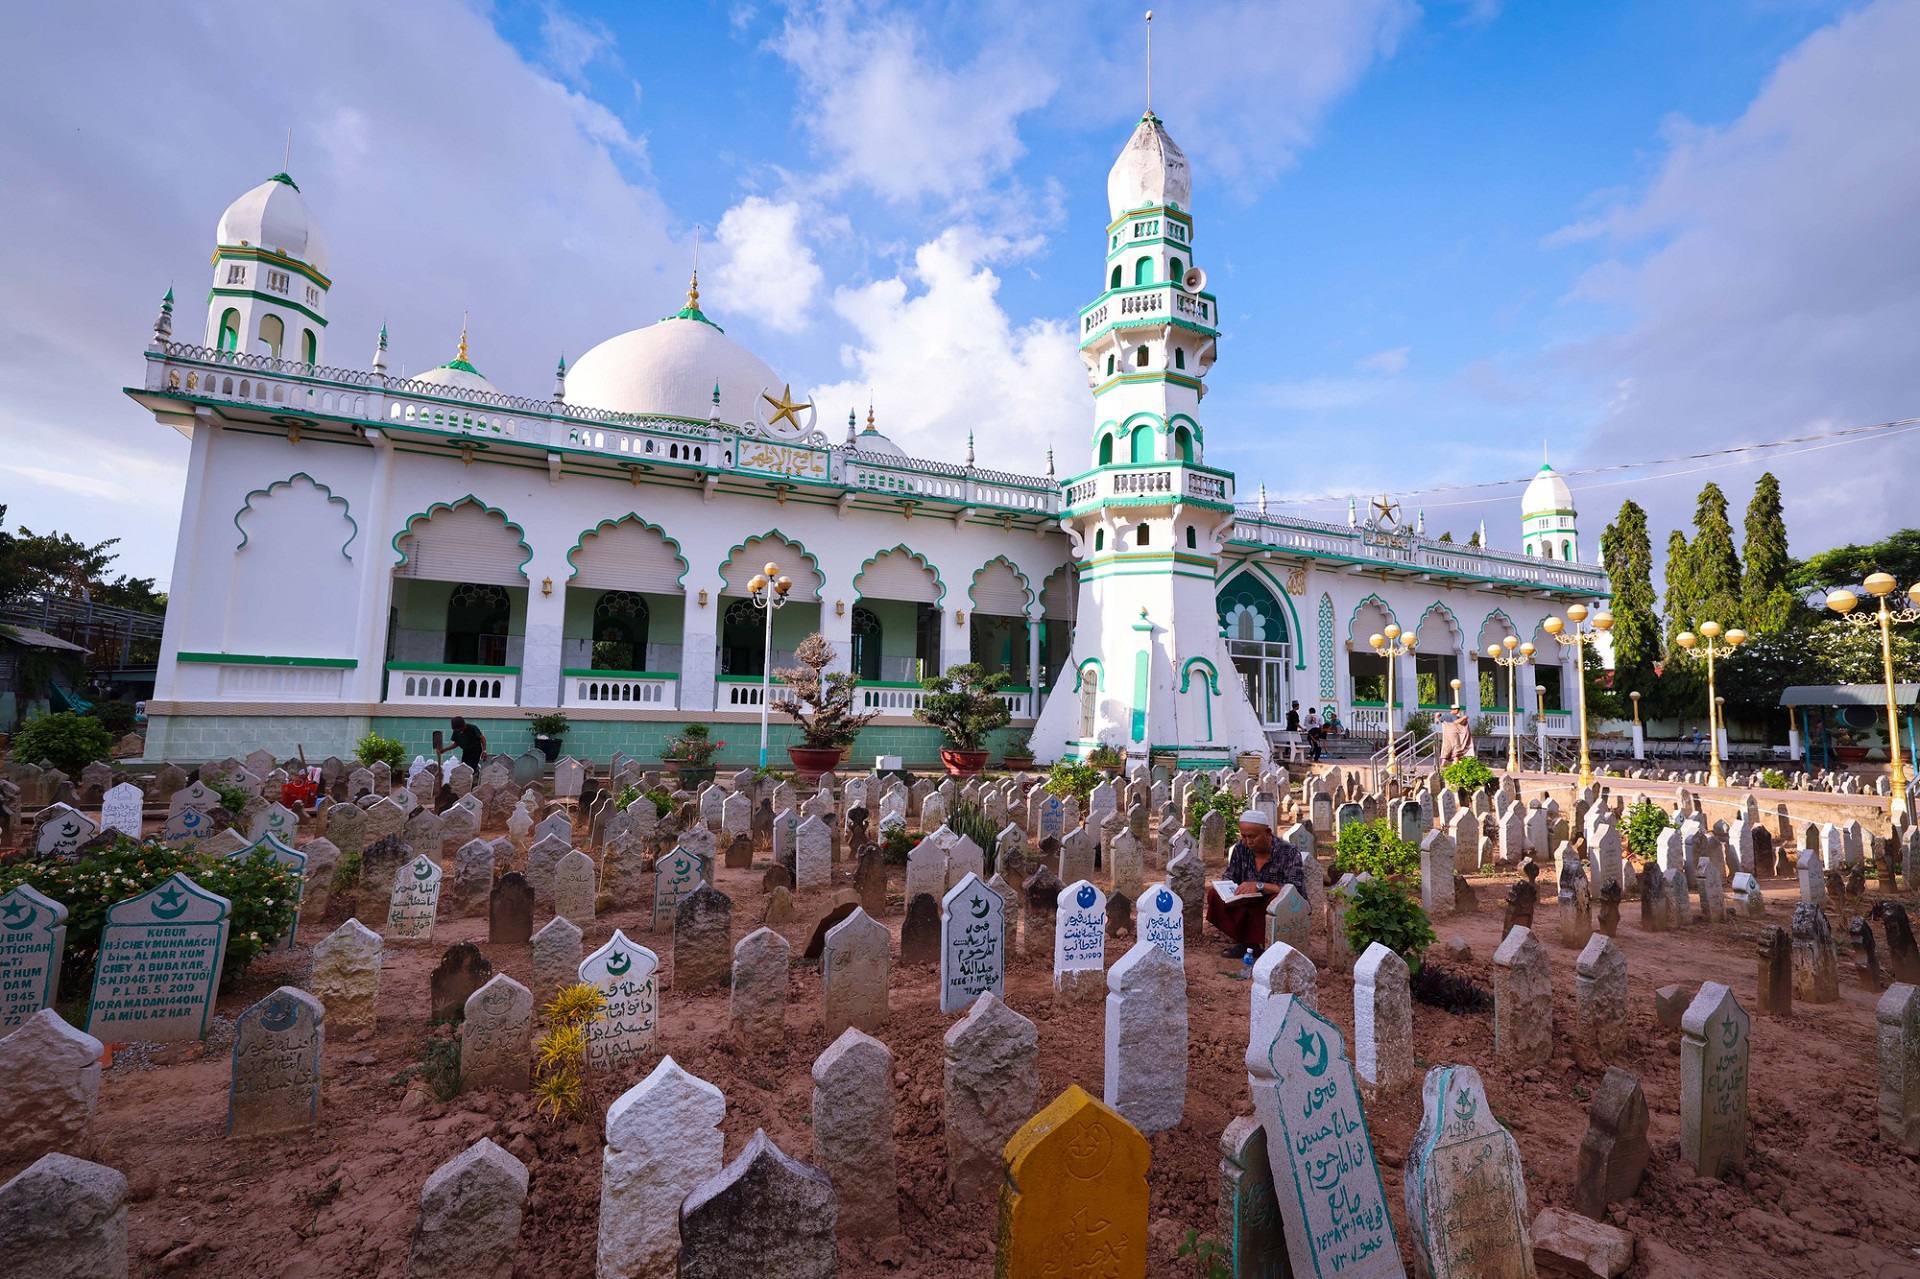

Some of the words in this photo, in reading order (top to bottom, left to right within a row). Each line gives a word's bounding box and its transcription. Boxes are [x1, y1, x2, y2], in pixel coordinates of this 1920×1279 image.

[966, 920, 990, 933] قبور
[147, 928, 186, 938] KUBUR
[168, 984, 194, 993] 2019
[6, 991, 35, 1002] 1945
[10, 1003, 39, 1014] 2017
[4, 1016, 21, 1026] 72
[1303, 1077, 1337, 1119] قبور
[1296, 1129, 1334, 1156] حسين
[1328, 1185, 1361, 1225] صالح
